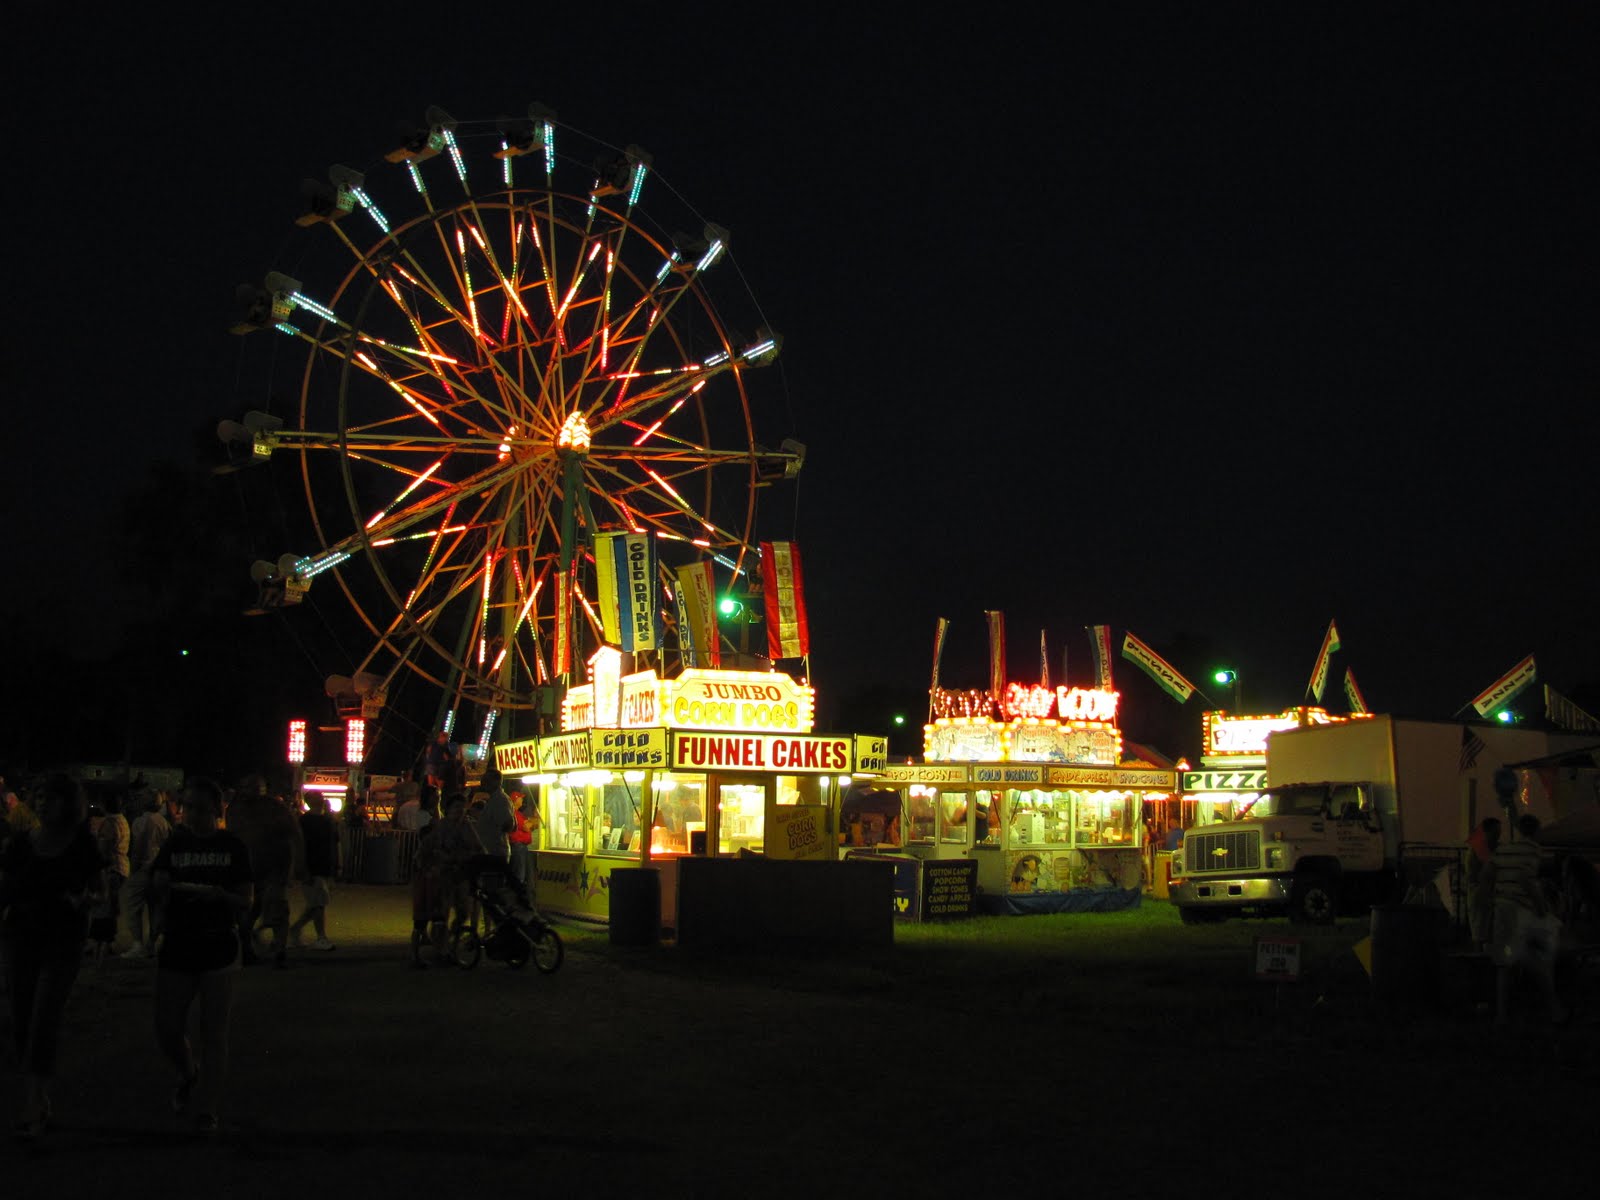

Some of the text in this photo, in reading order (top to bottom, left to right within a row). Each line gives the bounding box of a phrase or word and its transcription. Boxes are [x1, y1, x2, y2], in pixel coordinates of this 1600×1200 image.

[630, 543, 649, 641] COLD DRINKS
[703, 683, 782, 701] JUMBO
[1481, 664, 1534, 709] PIZZA
[674, 696, 798, 728] CORN DOGS
[603, 732, 650, 747] COLD
[872, 742, 885, 753] CO
[497, 744, 535, 770] NACHOS
[553, 740, 569, 766] CORN
[570, 737, 588, 764] DOGS
[595, 750, 662, 765] DRINKS
[678, 737, 847, 769] FUNNEL CAKES
[892, 769, 951, 781] POP CORN
[978, 769, 1038, 782] COLD DRINKS
[787, 815, 816, 836] CORN
[789, 831, 817, 849] DOGS
[929, 868, 952, 877] COTTON
[934, 877, 966, 885] POPCORN
[928, 895, 948, 903] CANDY
[930, 904, 968, 913] COLD DRINKS
